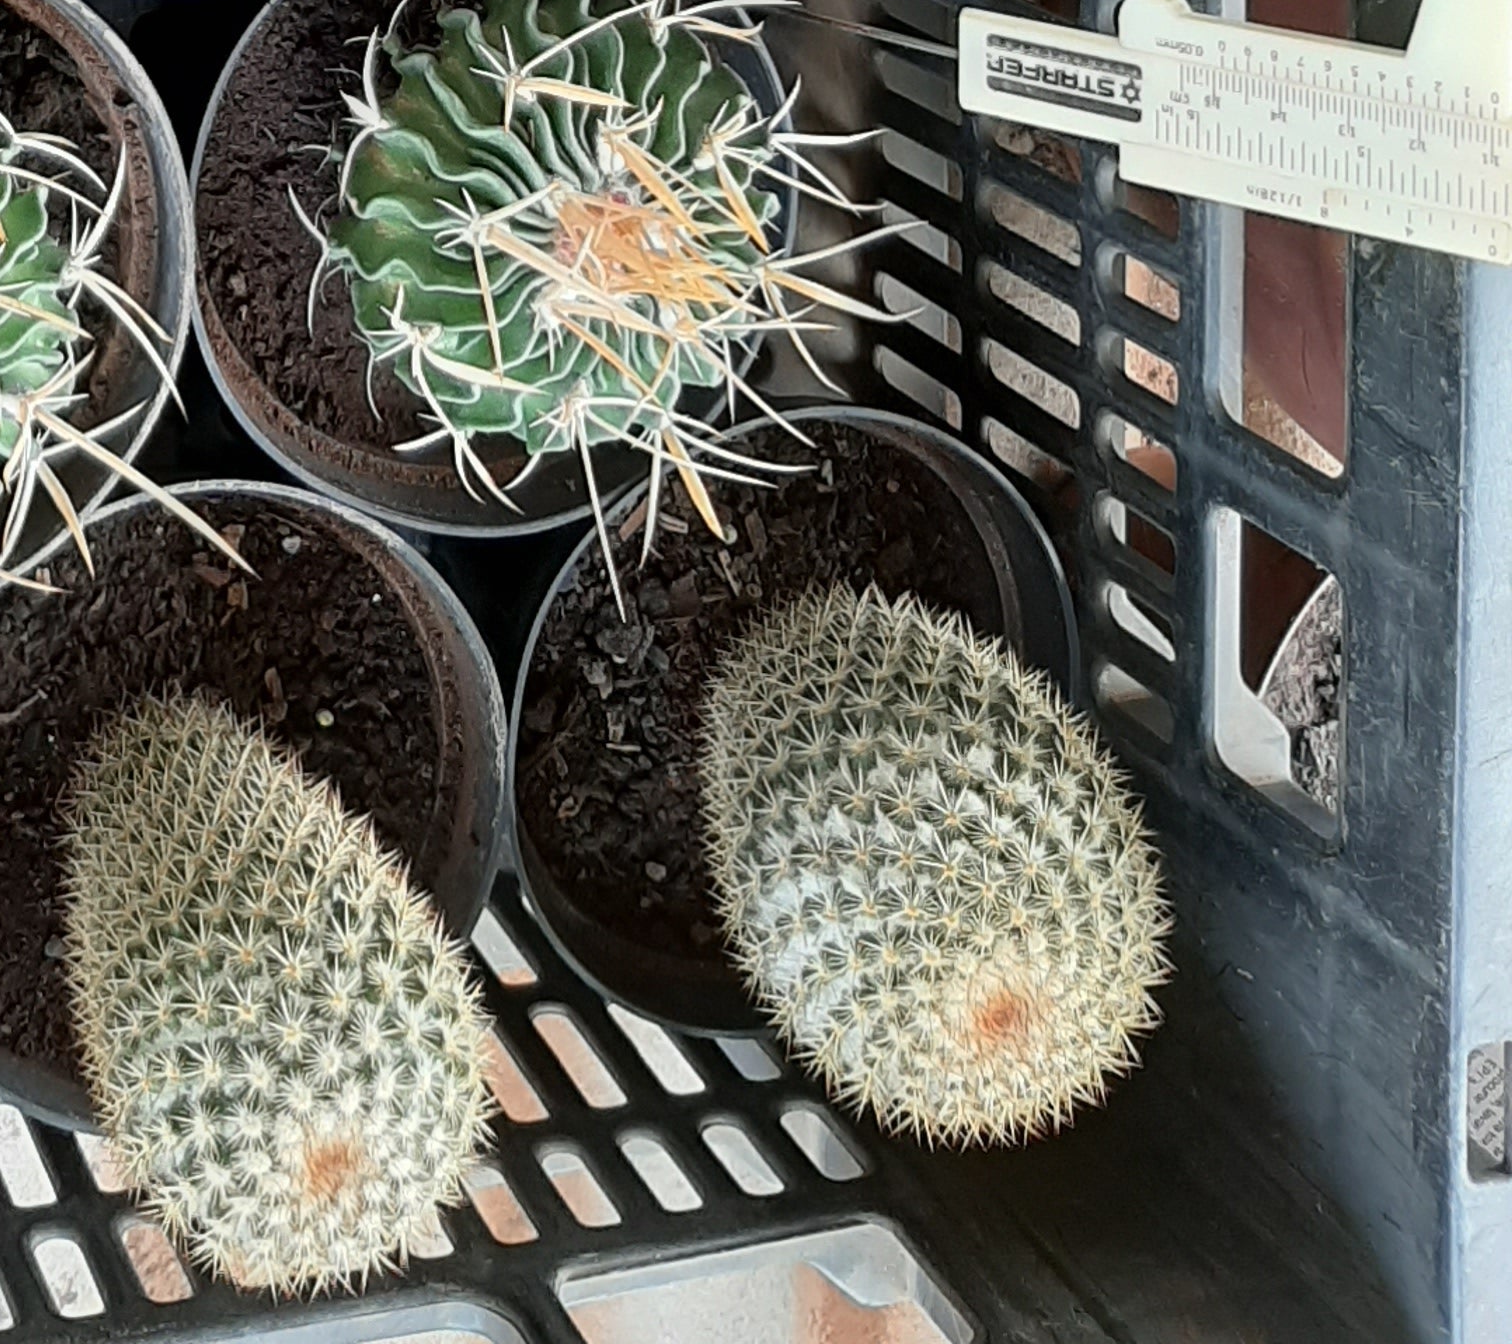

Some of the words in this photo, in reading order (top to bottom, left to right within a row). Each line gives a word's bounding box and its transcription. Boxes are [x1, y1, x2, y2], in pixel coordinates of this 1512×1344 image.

[1296, 56, 1304, 67] 7
[1324, 60, 1332, 72] 6
[1351, 65, 1359, 77] 5
[1406, 76, 1414, 88] 3
[1434, 81, 1442, 93] 2
[1169, 90, 1190, 104] cm
